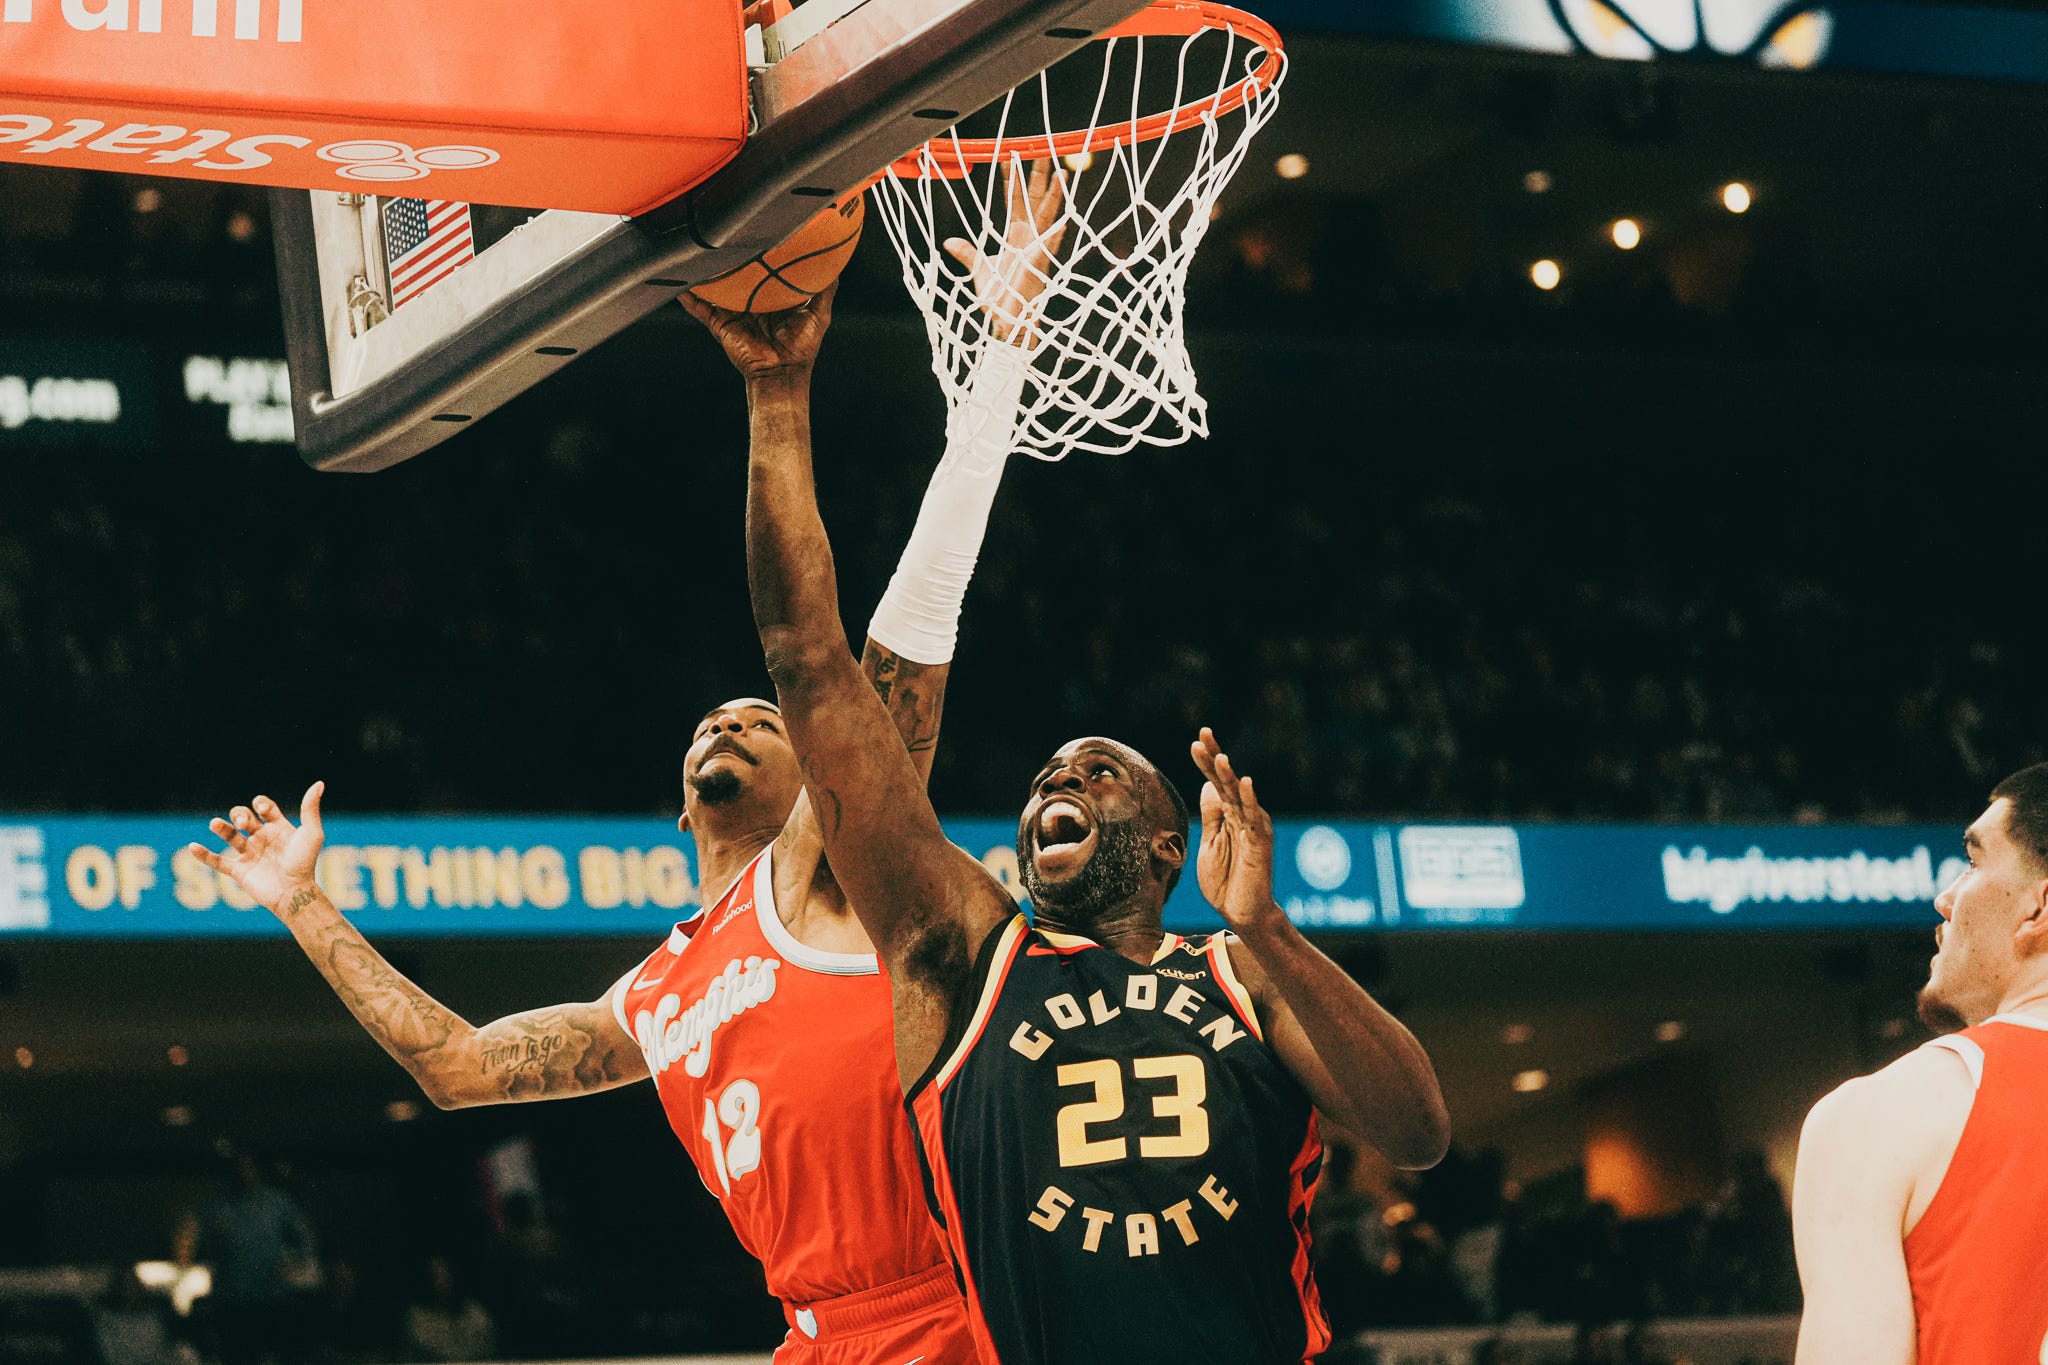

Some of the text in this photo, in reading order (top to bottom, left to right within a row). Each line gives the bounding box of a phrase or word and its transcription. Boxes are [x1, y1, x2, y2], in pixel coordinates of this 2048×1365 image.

[0, 114, 312, 170] State
[66, 845, 156, 910] OF
[171, 845, 571, 911] SOETHING
[634, 955, 781, 1078] Memphis
[1009, 974, 1248, 1061] GOLDEN
[702, 1079, 761, 1197] 12
[1056, 1054, 1210, 1168] 23
[1027, 1174, 1239, 1257] STATE
